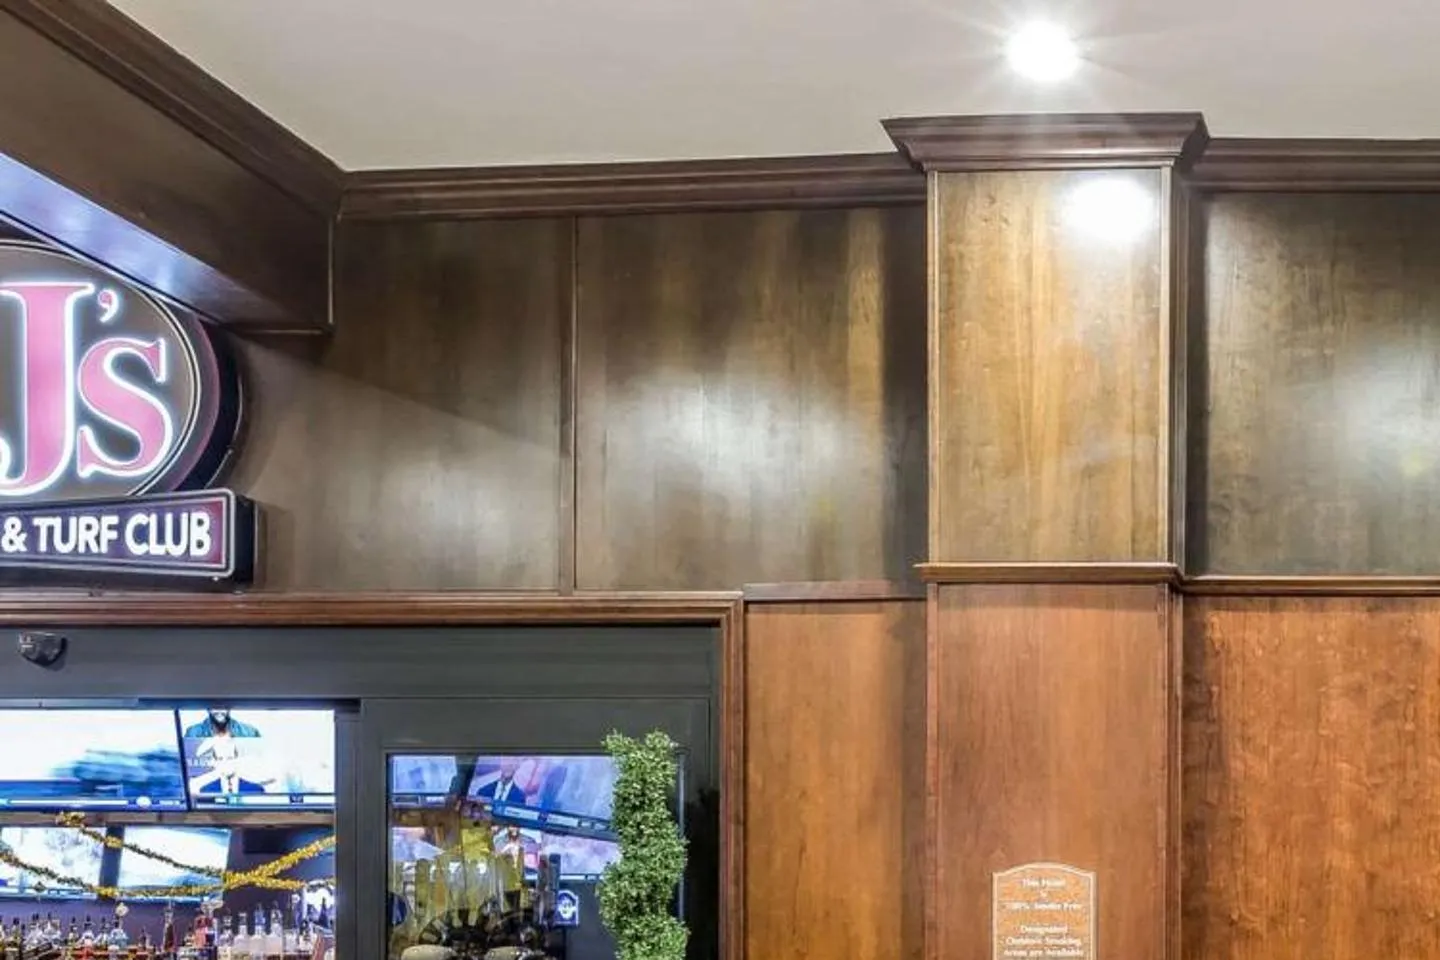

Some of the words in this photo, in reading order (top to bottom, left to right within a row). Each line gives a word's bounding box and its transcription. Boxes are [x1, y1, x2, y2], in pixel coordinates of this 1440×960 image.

[1, 516, 28, 553] &
[33, 514, 118, 555] TURF
[124, 511, 211, 557] CLUB
